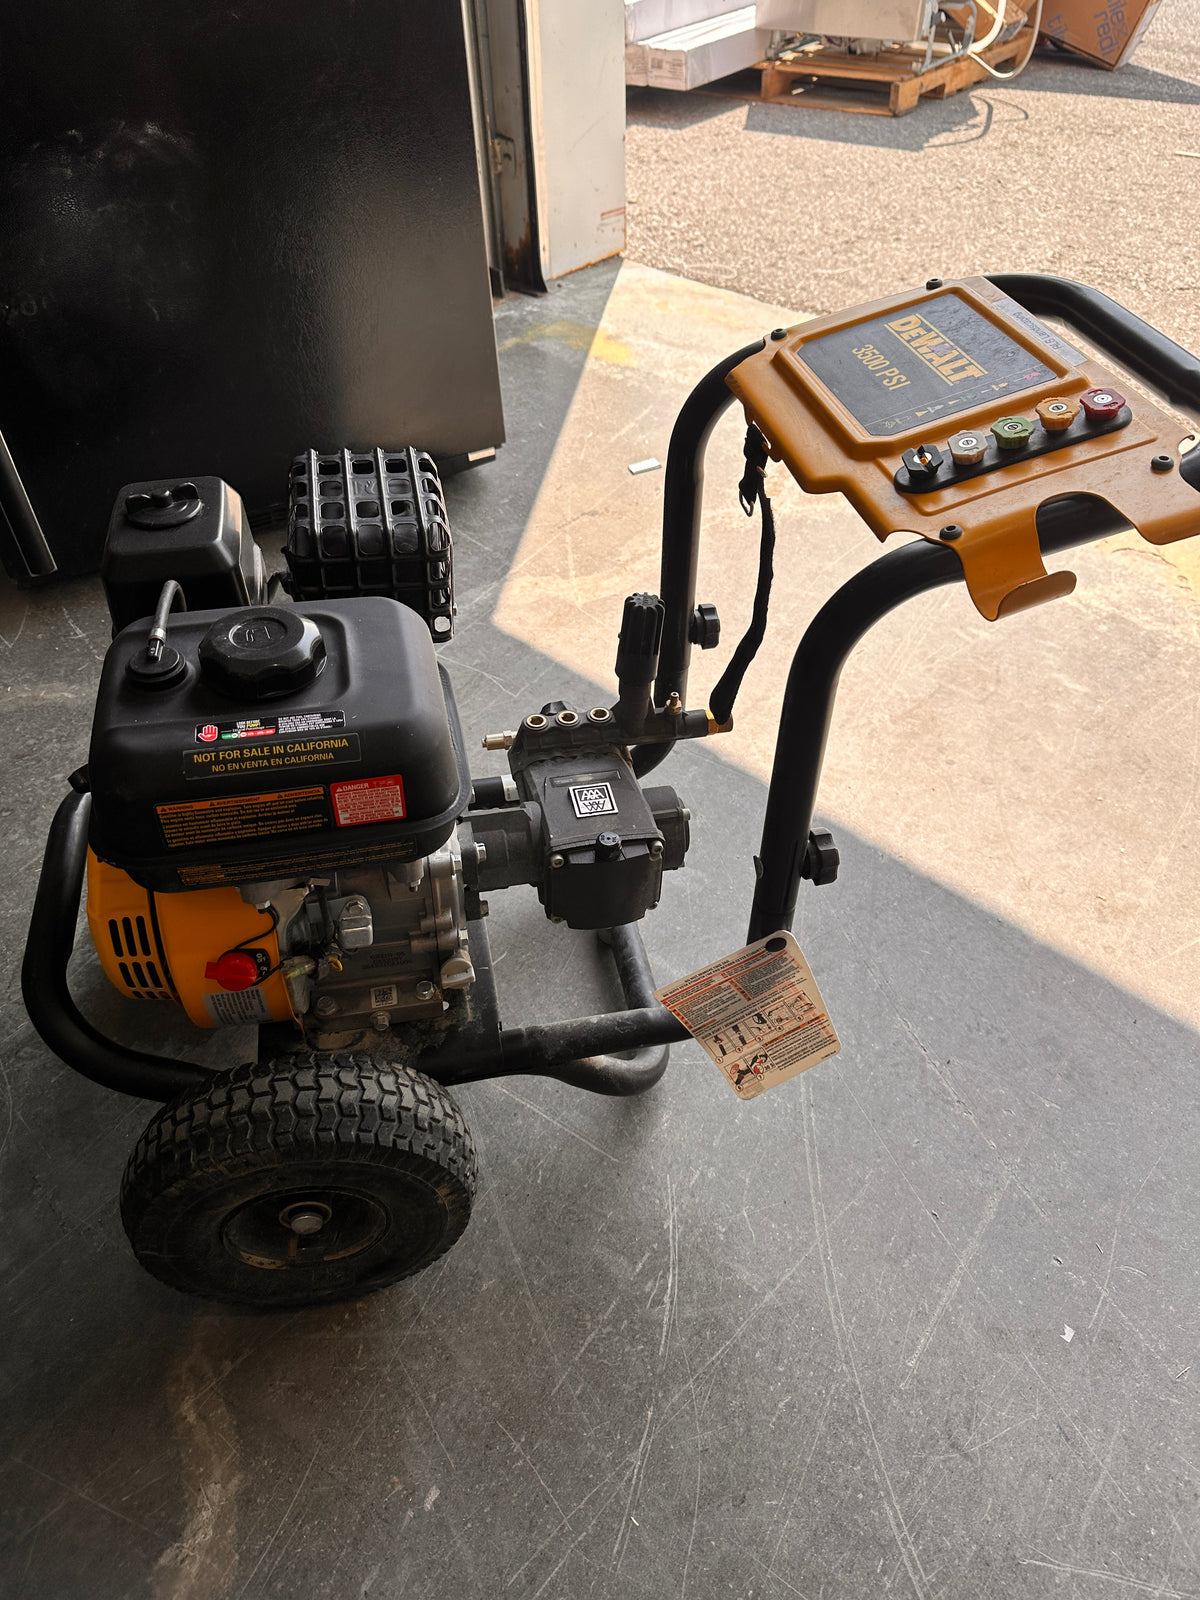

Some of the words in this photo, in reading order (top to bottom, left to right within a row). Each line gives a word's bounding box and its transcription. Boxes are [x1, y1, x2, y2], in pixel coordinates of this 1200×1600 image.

[1106, 0, 1128, 26] ile
[1094, 10, 1120, 57] redi
[852, 344, 890, 371] 3500
[875, 367, 911, 391] PSI
[193, 753, 215, 763] NOT
[219, 749, 241, 761] FOR
[244, 746, 271, 758] SALE
[272, 744, 285, 755] IN
[286, 738, 349, 753] CALIFORNIA
[211, 763, 226, 773] NO
[227, 762, 240, 771] EN
[240, 758, 269, 770] VENTA
[271, 756, 283, 766] EN
[284, 752, 334, 764] CALIFORNIA
[342, 782, 369, 792] DANGER
